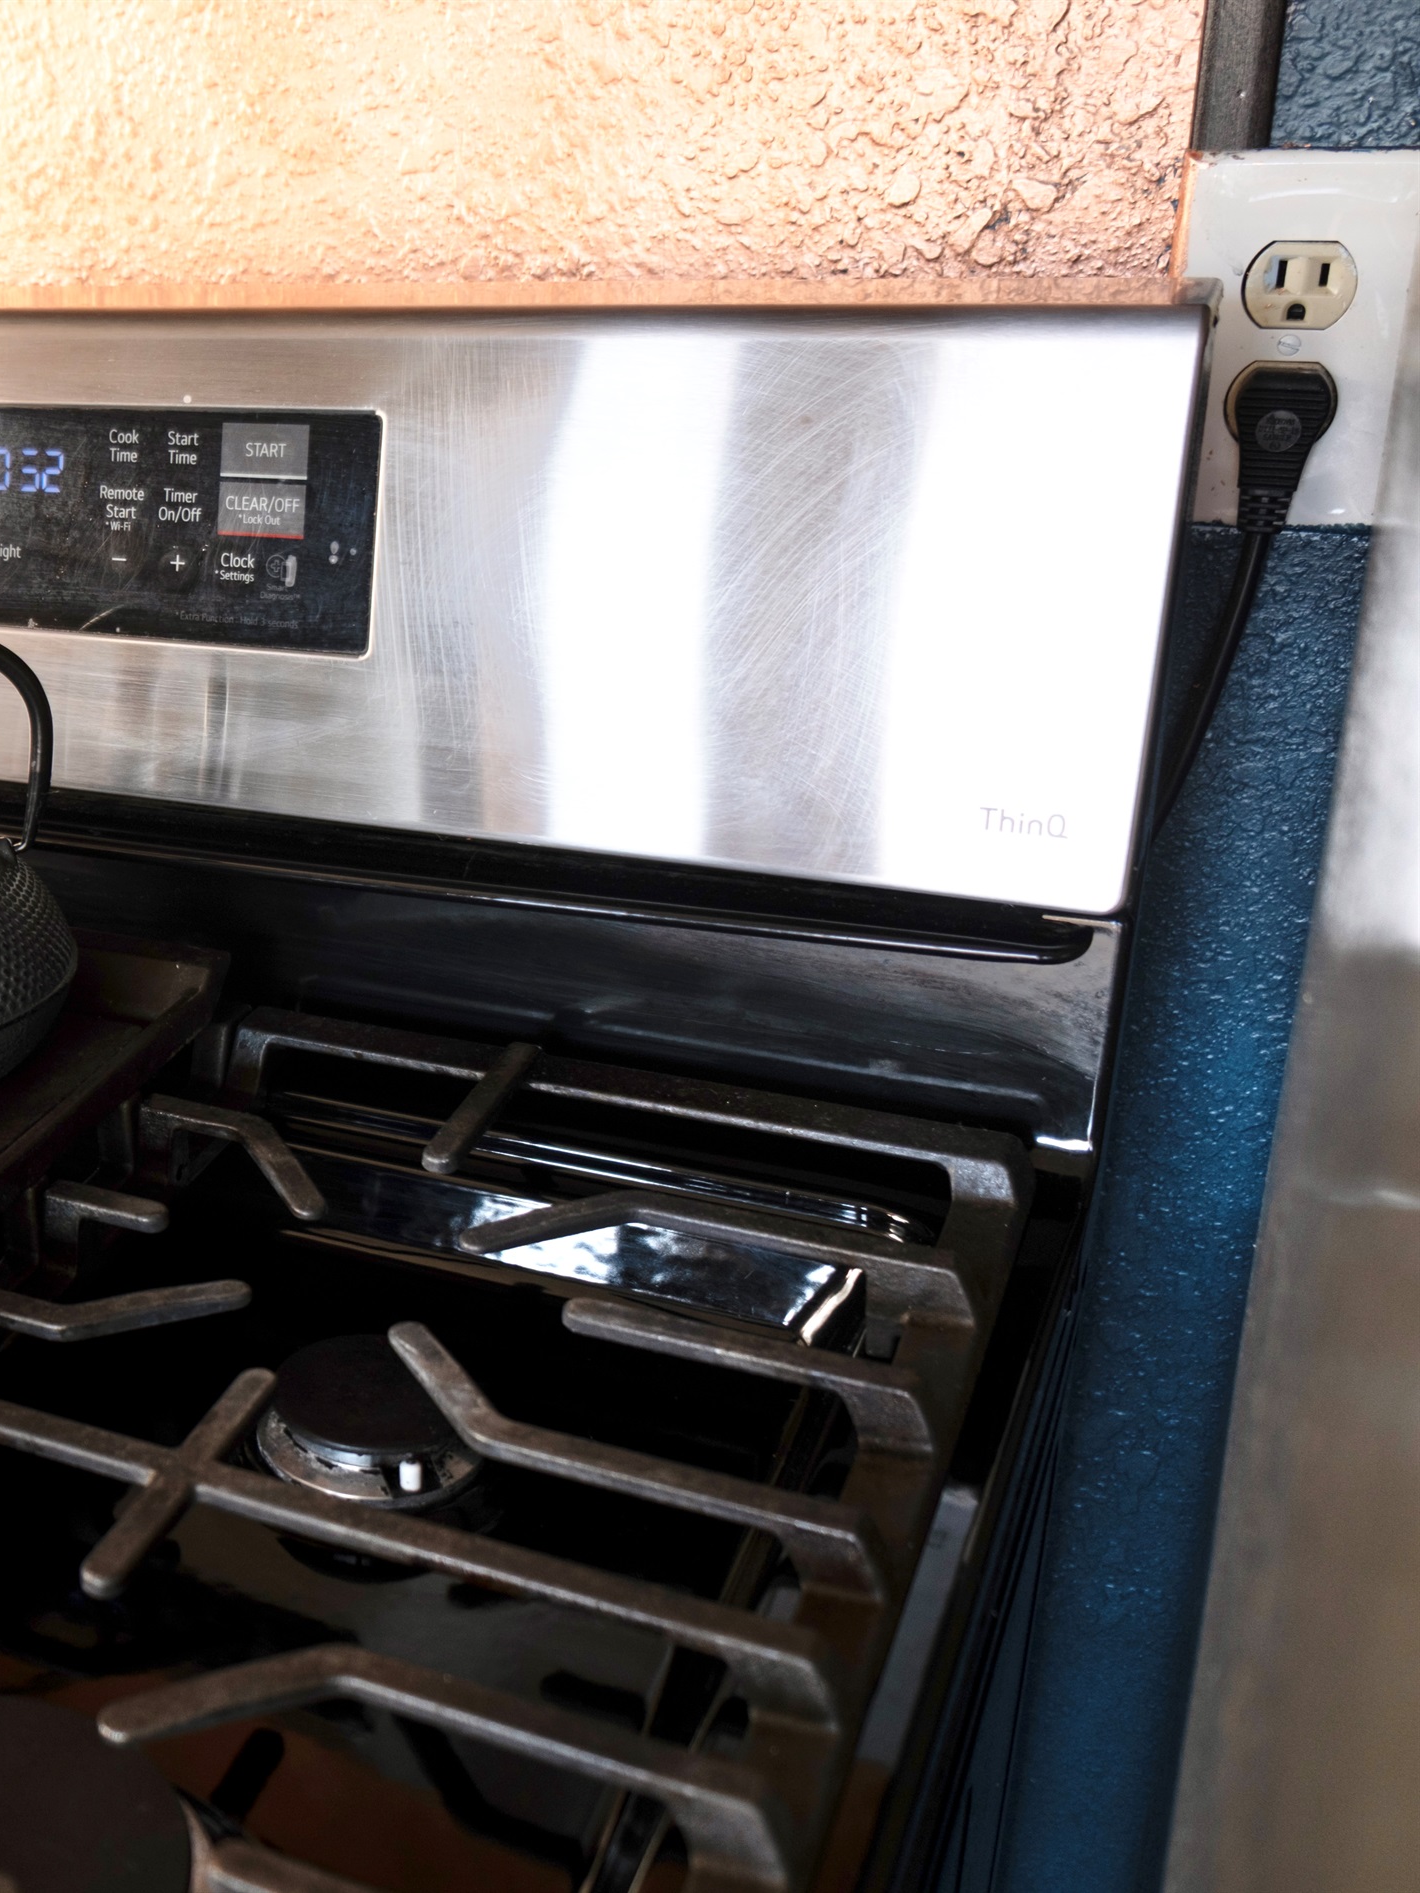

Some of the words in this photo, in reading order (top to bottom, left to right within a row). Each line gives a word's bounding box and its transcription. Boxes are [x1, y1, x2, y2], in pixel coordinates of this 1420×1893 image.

[109, 429, 139, 444] Cook
[167, 430, 199, 446] Start
[109, 447, 138, 463] Time
[168, 449, 197, 465] Time
[245, 442, 287, 458] START
[100, 485, 145, 501] Remote
[163, 488, 198, 503] Timer
[106, 504, 137, 519] Start
[225, 496, 300, 513] CLEAR/OFF
[158, 506, 202, 523] On/Off
[243, 514, 262, 525] Lock
[264, 514, 281, 526] Out
[220, 552, 255, 569] Clock
[220, 570, 255, 584] Settings
[180, 610, 200, 622] Extra
[202, 612, 234, 624] Function
[240, 615, 258, 626] Hold
[267, 619, 299, 630] seconds
[980, 806, 1068, 839] ThinQ
